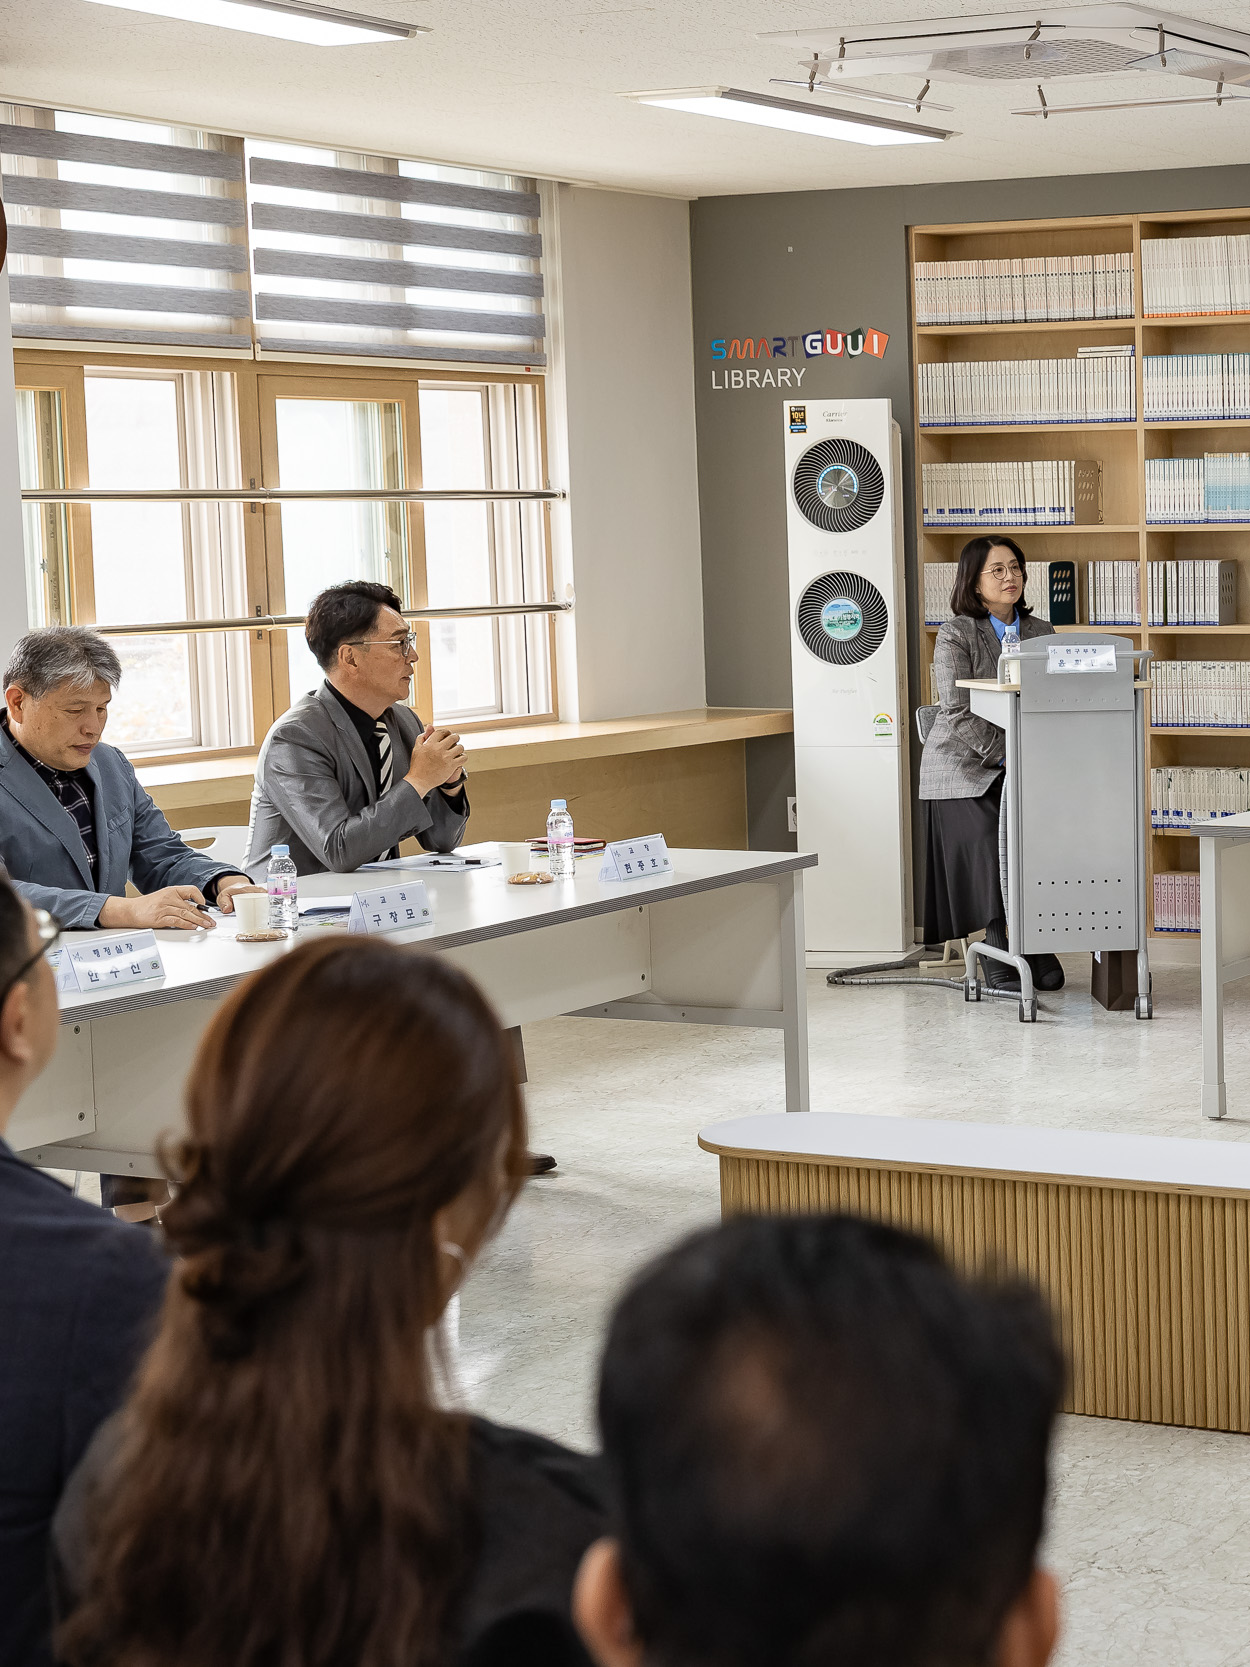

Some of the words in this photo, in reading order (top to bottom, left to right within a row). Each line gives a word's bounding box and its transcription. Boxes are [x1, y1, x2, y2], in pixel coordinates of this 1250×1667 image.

[711, 336, 799, 360] SMART
[804, 333, 879, 356] GUUI
[711, 367, 806, 390] LIBRARY
[379, 892, 407, 904] 교감
[372, 907, 416, 927] 구창모
[92, 942, 133, 958] 행정실장
